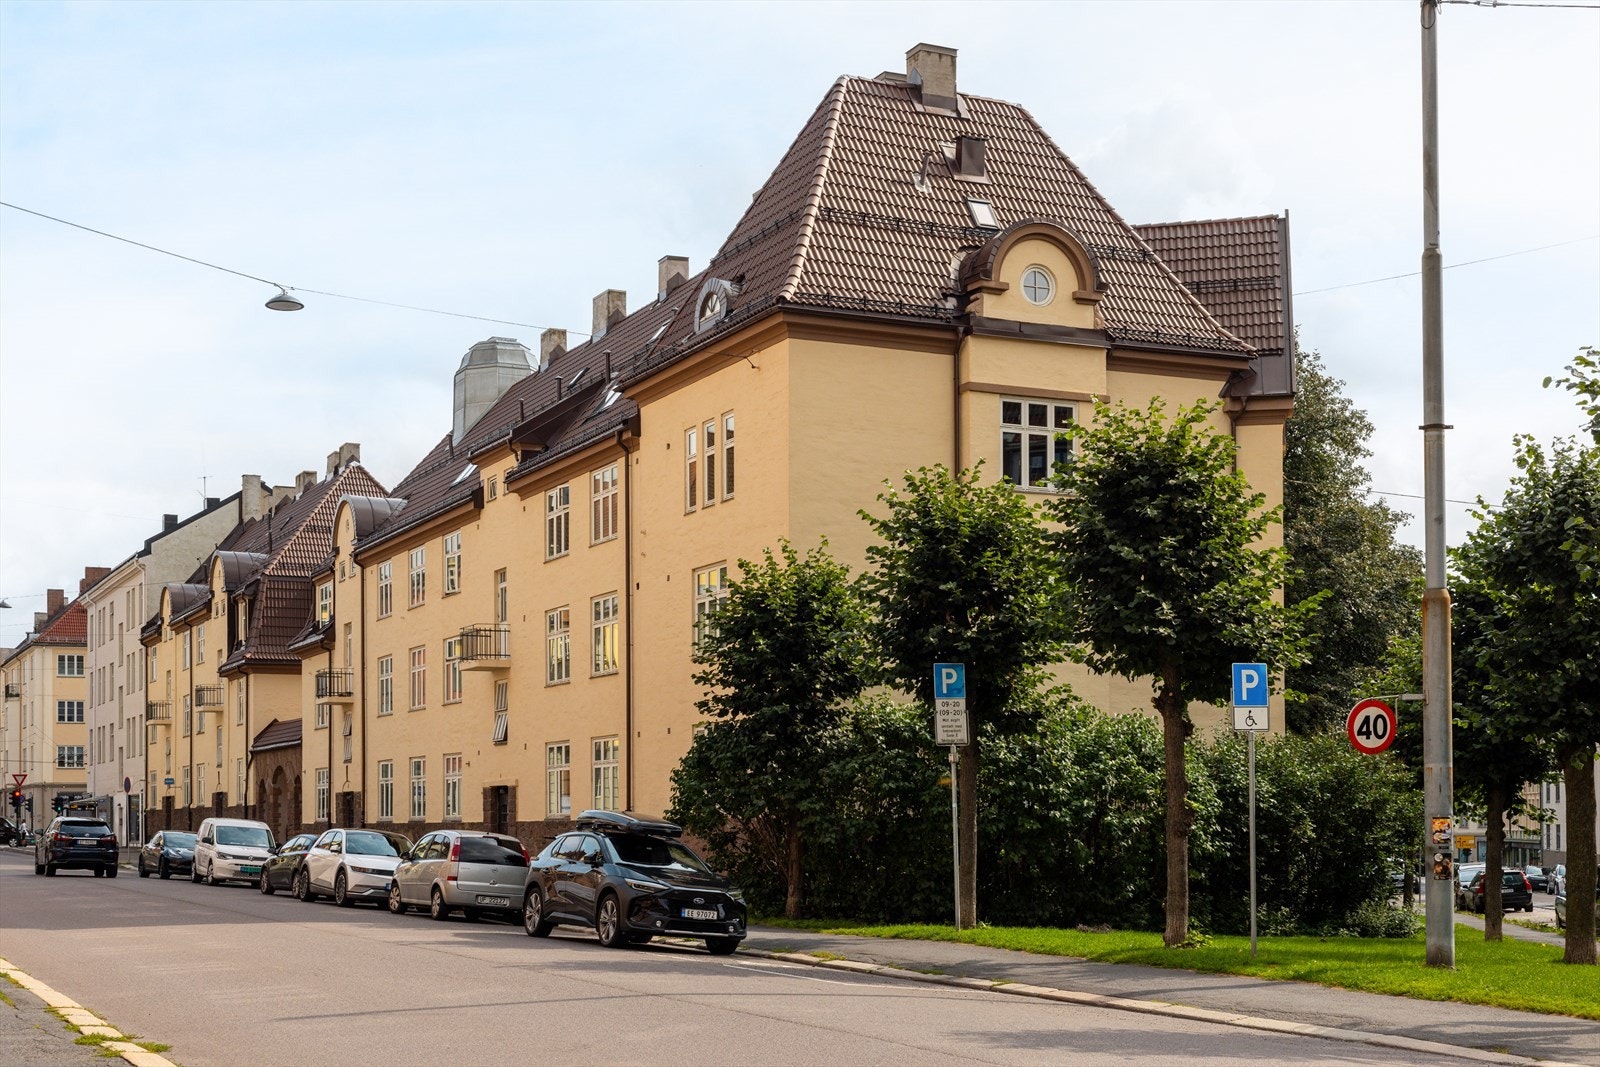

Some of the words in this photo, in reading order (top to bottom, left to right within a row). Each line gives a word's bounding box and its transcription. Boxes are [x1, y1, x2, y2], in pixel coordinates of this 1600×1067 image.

[941, 668, 957, 694] P
[1241, 669, 1259, 701] P
[1357, 714, 1388, 740] 40
